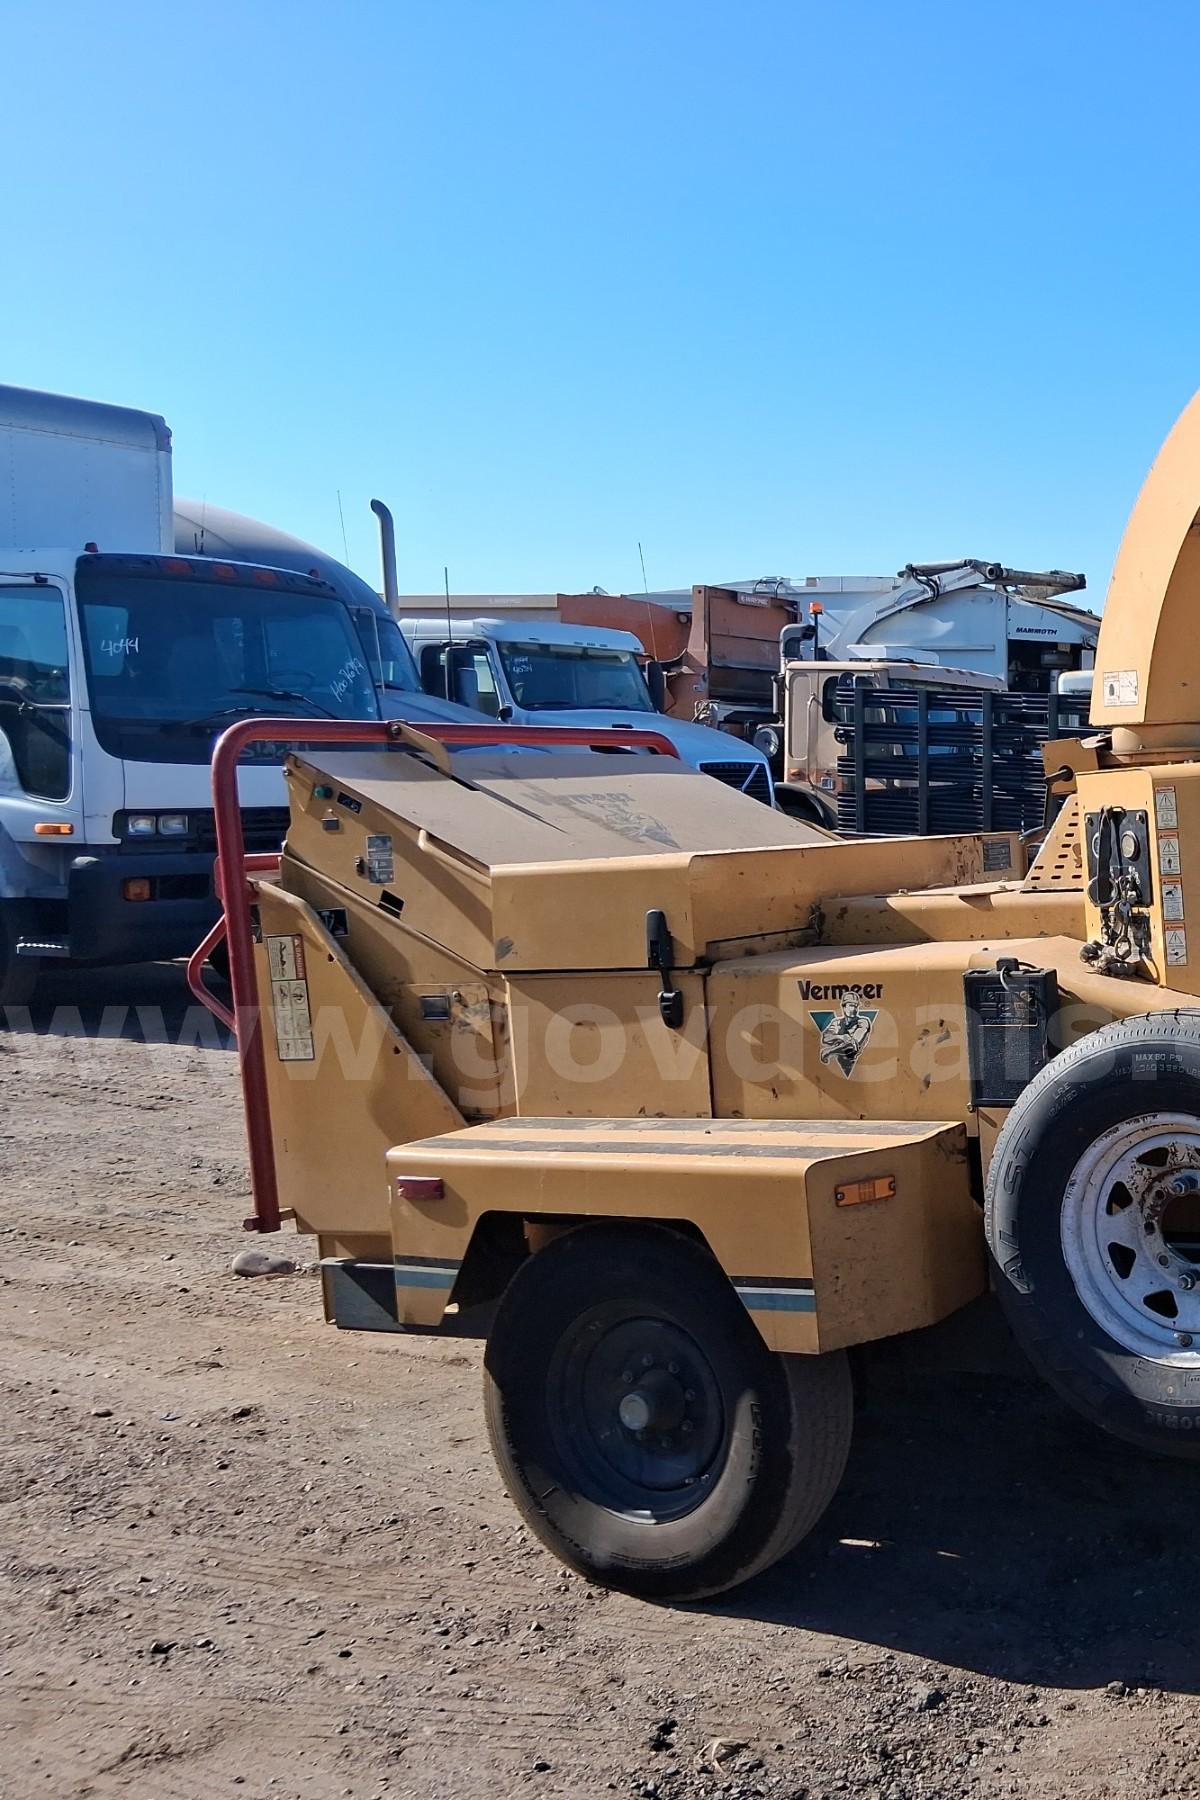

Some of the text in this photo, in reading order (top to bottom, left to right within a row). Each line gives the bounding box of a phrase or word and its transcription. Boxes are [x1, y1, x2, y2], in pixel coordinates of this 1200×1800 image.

[1015, 626, 1058, 636] MAMMOTH
[100, 636, 139, 657] 4044
[797, 980, 883, 1001] Vermeer
[1135, 1053, 1153, 1062] MAX
